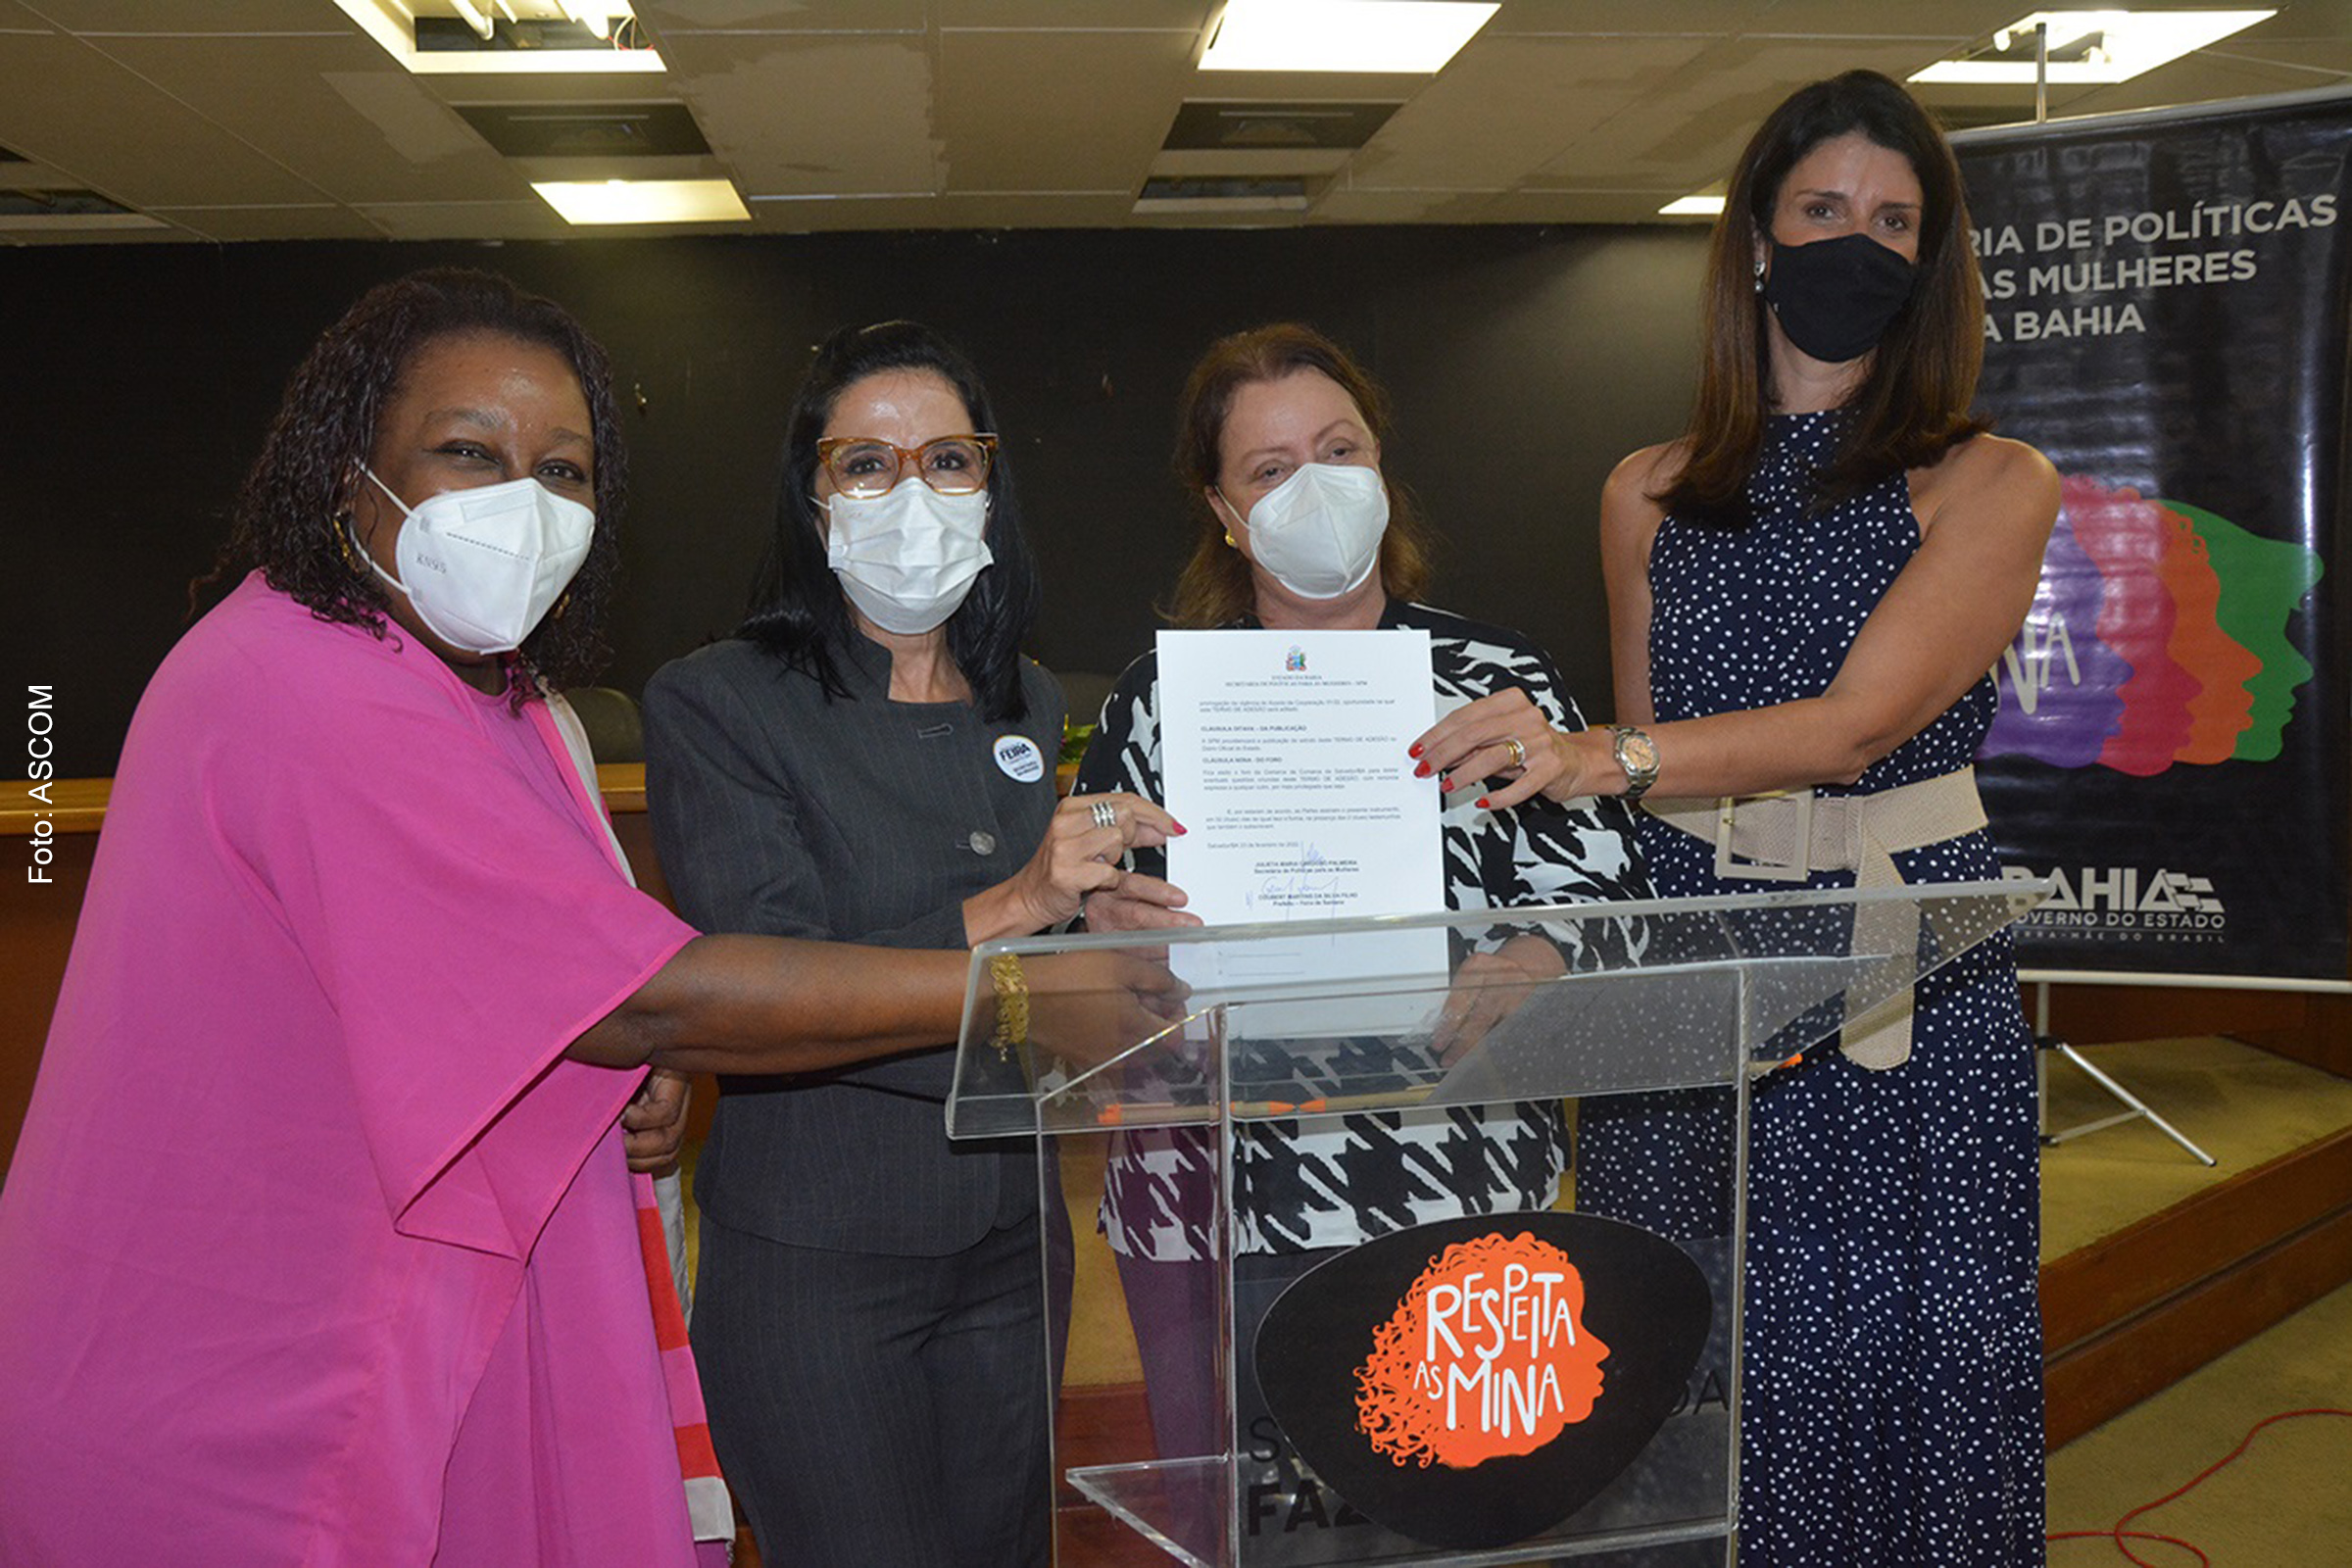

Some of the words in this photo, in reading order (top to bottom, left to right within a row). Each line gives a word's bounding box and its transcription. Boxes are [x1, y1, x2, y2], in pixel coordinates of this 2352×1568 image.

[2036, 219, 2091, 251] DE
[2104, 194, 2338, 246] POLÍTICAS
[2029, 249, 2258, 296] MULHERES
[2014, 304, 2146, 341] BAHIA
[2001, 865, 2189, 913] BAHIA
[2012, 930, 2104, 941] ERRA-MÃE
[2157, 933, 2225, 944] BRASIL
[2014, 910, 2098, 927] OVERNO
[2106, 912, 2136, 927] DO
[2143, 913, 2226, 930] ESTADO
[1426, 1263, 1576, 1361] RESPEITA
[1413, 1360, 1444, 1400] AS
[1446, 1359, 1565, 1438] MINA
